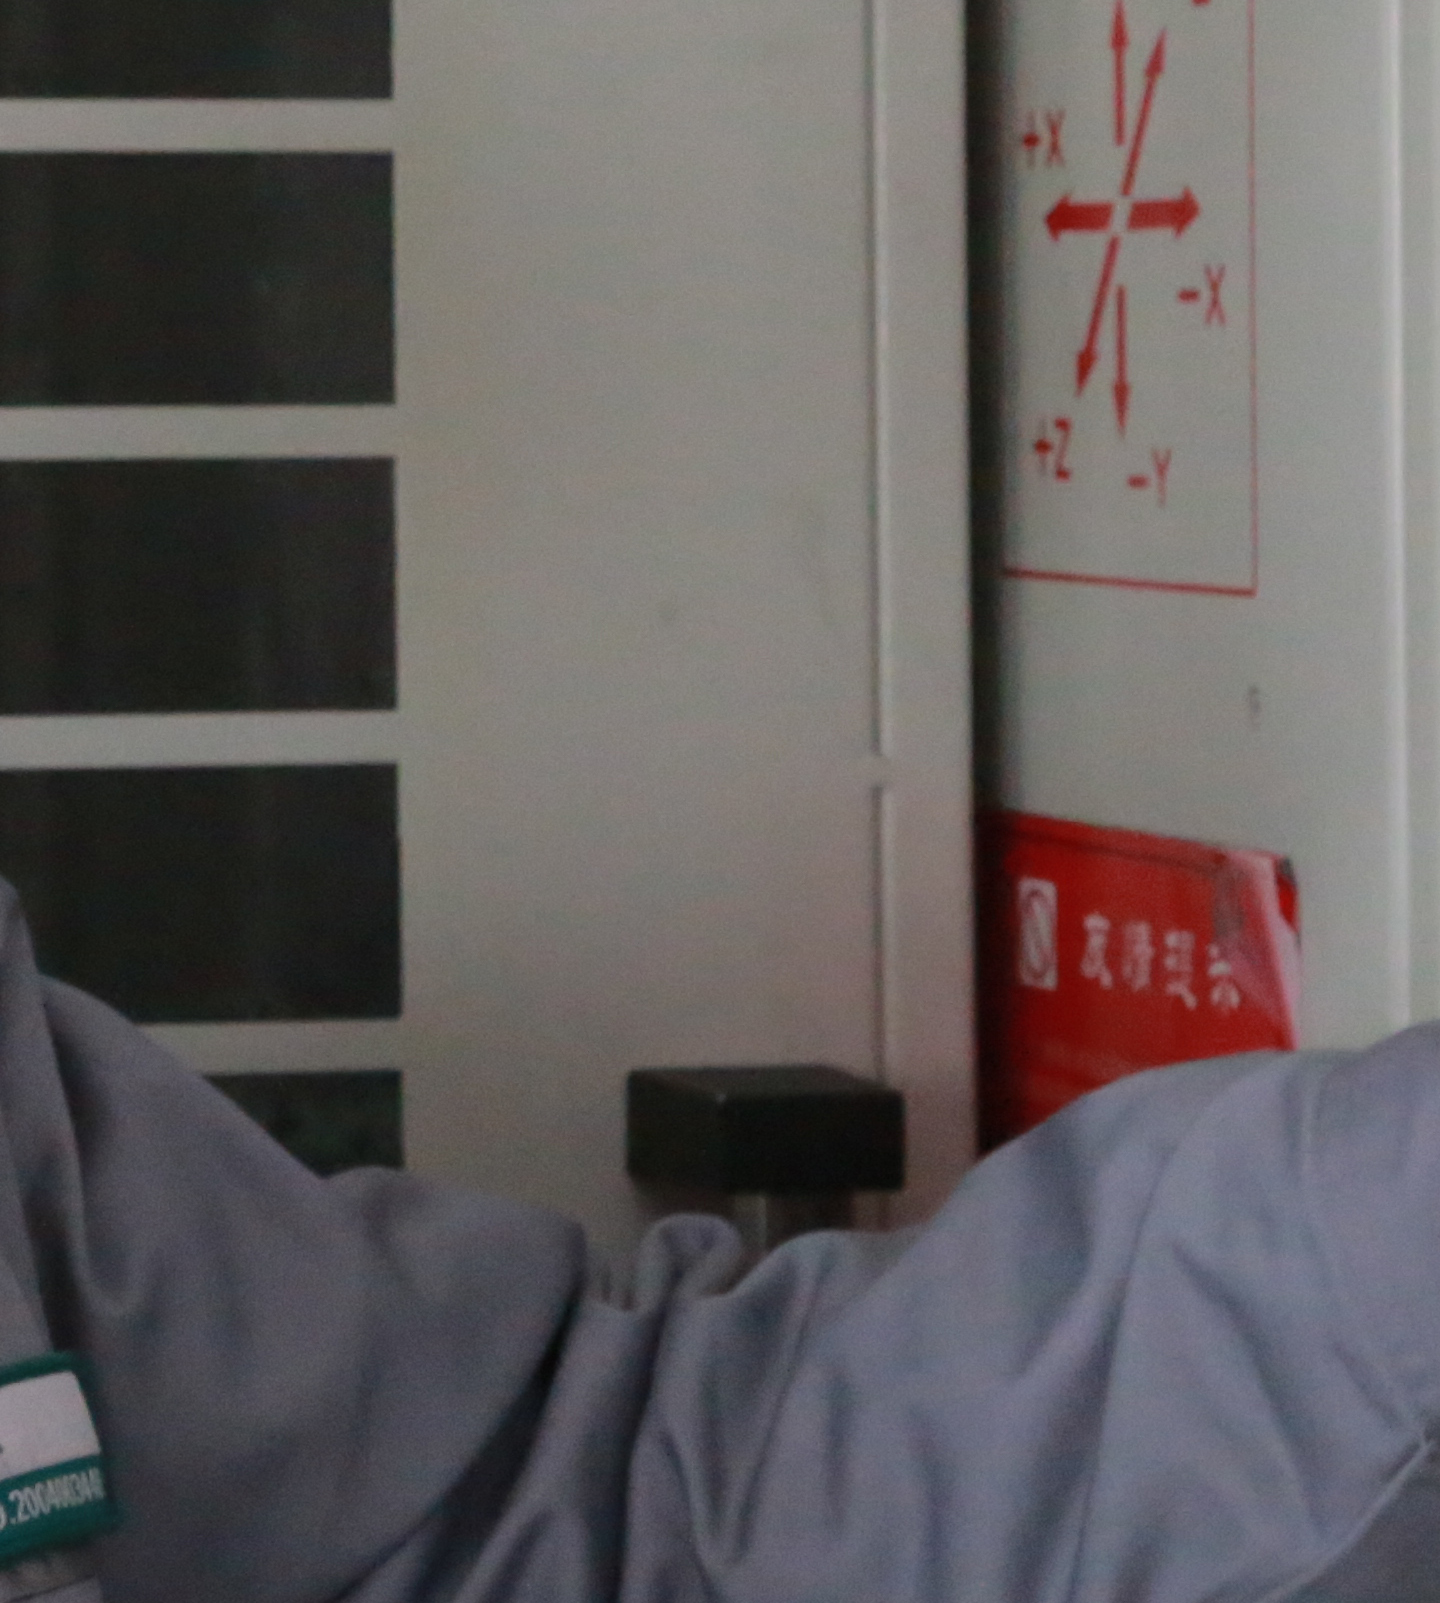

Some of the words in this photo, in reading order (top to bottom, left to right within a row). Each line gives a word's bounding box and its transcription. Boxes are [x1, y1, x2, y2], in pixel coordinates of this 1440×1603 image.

[1022, 109, 1065, 169] +X
[1178, 264, 1226, 326] -X
[1032, 417, 1072, 480] +Z
[1128, 448, 1172, 508] -Y
